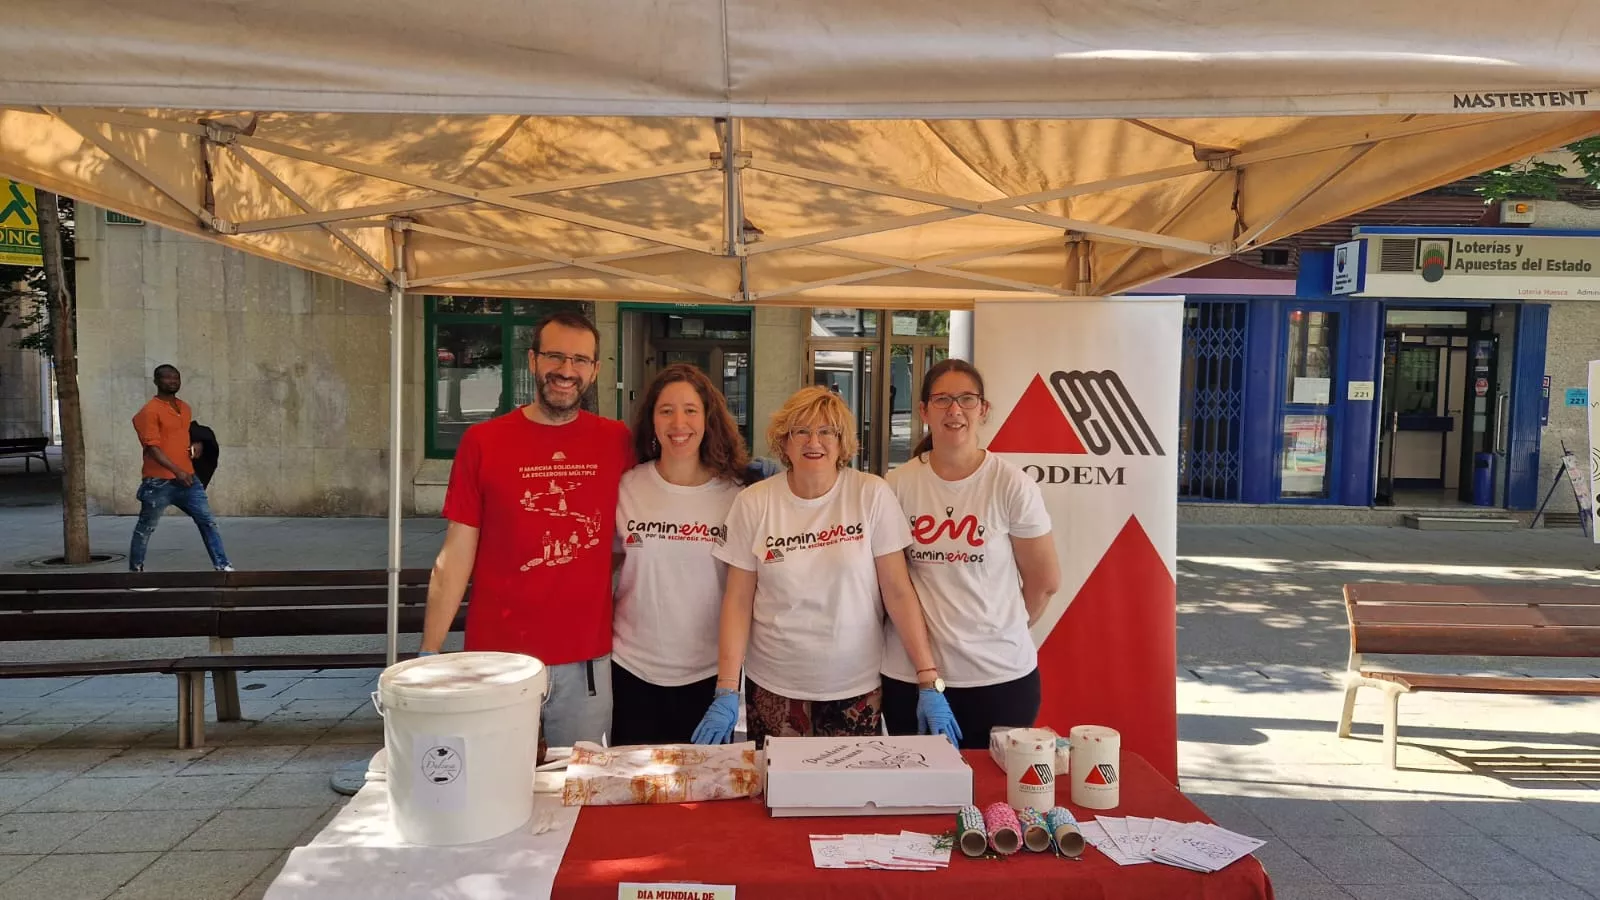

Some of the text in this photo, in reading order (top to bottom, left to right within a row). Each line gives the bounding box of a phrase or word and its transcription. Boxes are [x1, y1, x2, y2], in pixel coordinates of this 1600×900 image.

[1453, 91, 1589, 108] MASTERTENT
[1455, 241, 1524, 257] Loterías y
[1455, 258, 1592, 273] Apuestas del Estado
[807, 540, 839, 549] esclerosis
[637, 890, 715, 900] DIA MUNDIAL DE
